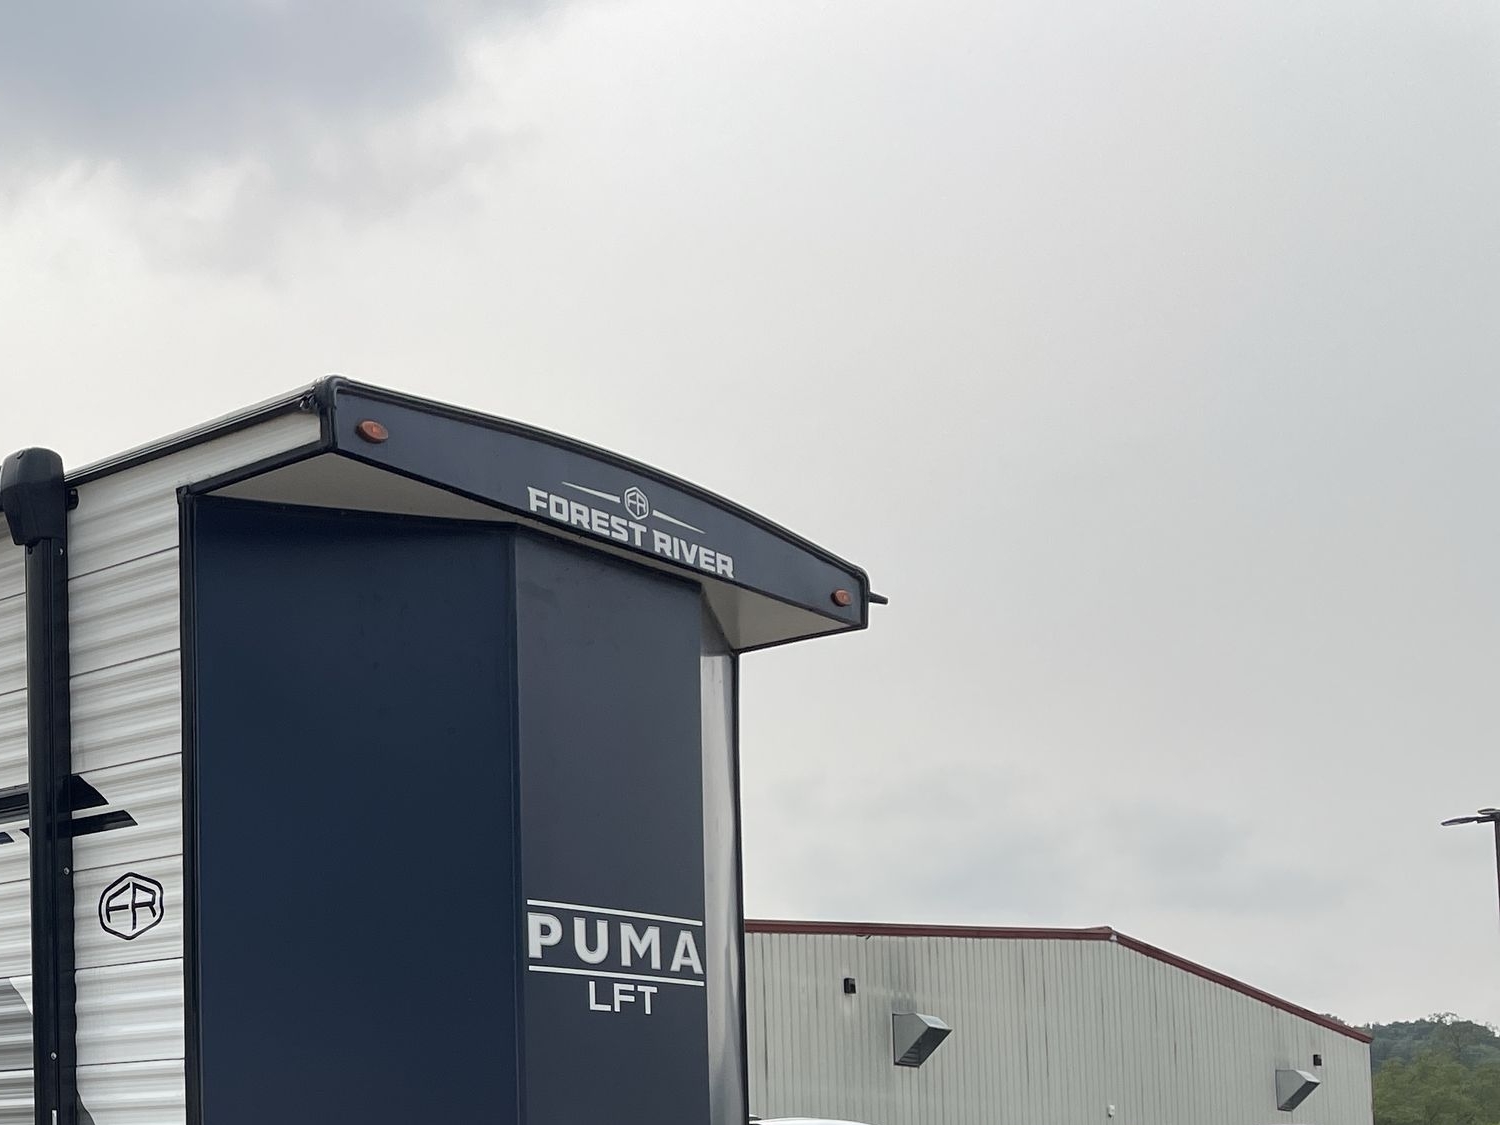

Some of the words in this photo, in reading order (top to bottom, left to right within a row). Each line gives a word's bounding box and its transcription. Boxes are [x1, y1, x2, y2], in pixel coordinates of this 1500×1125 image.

[527, 486, 647, 548] FOREST
[652, 529, 735, 578] RIVER
[527, 911, 704, 975] PUMA
[588, 980, 658, 1015] LFT
